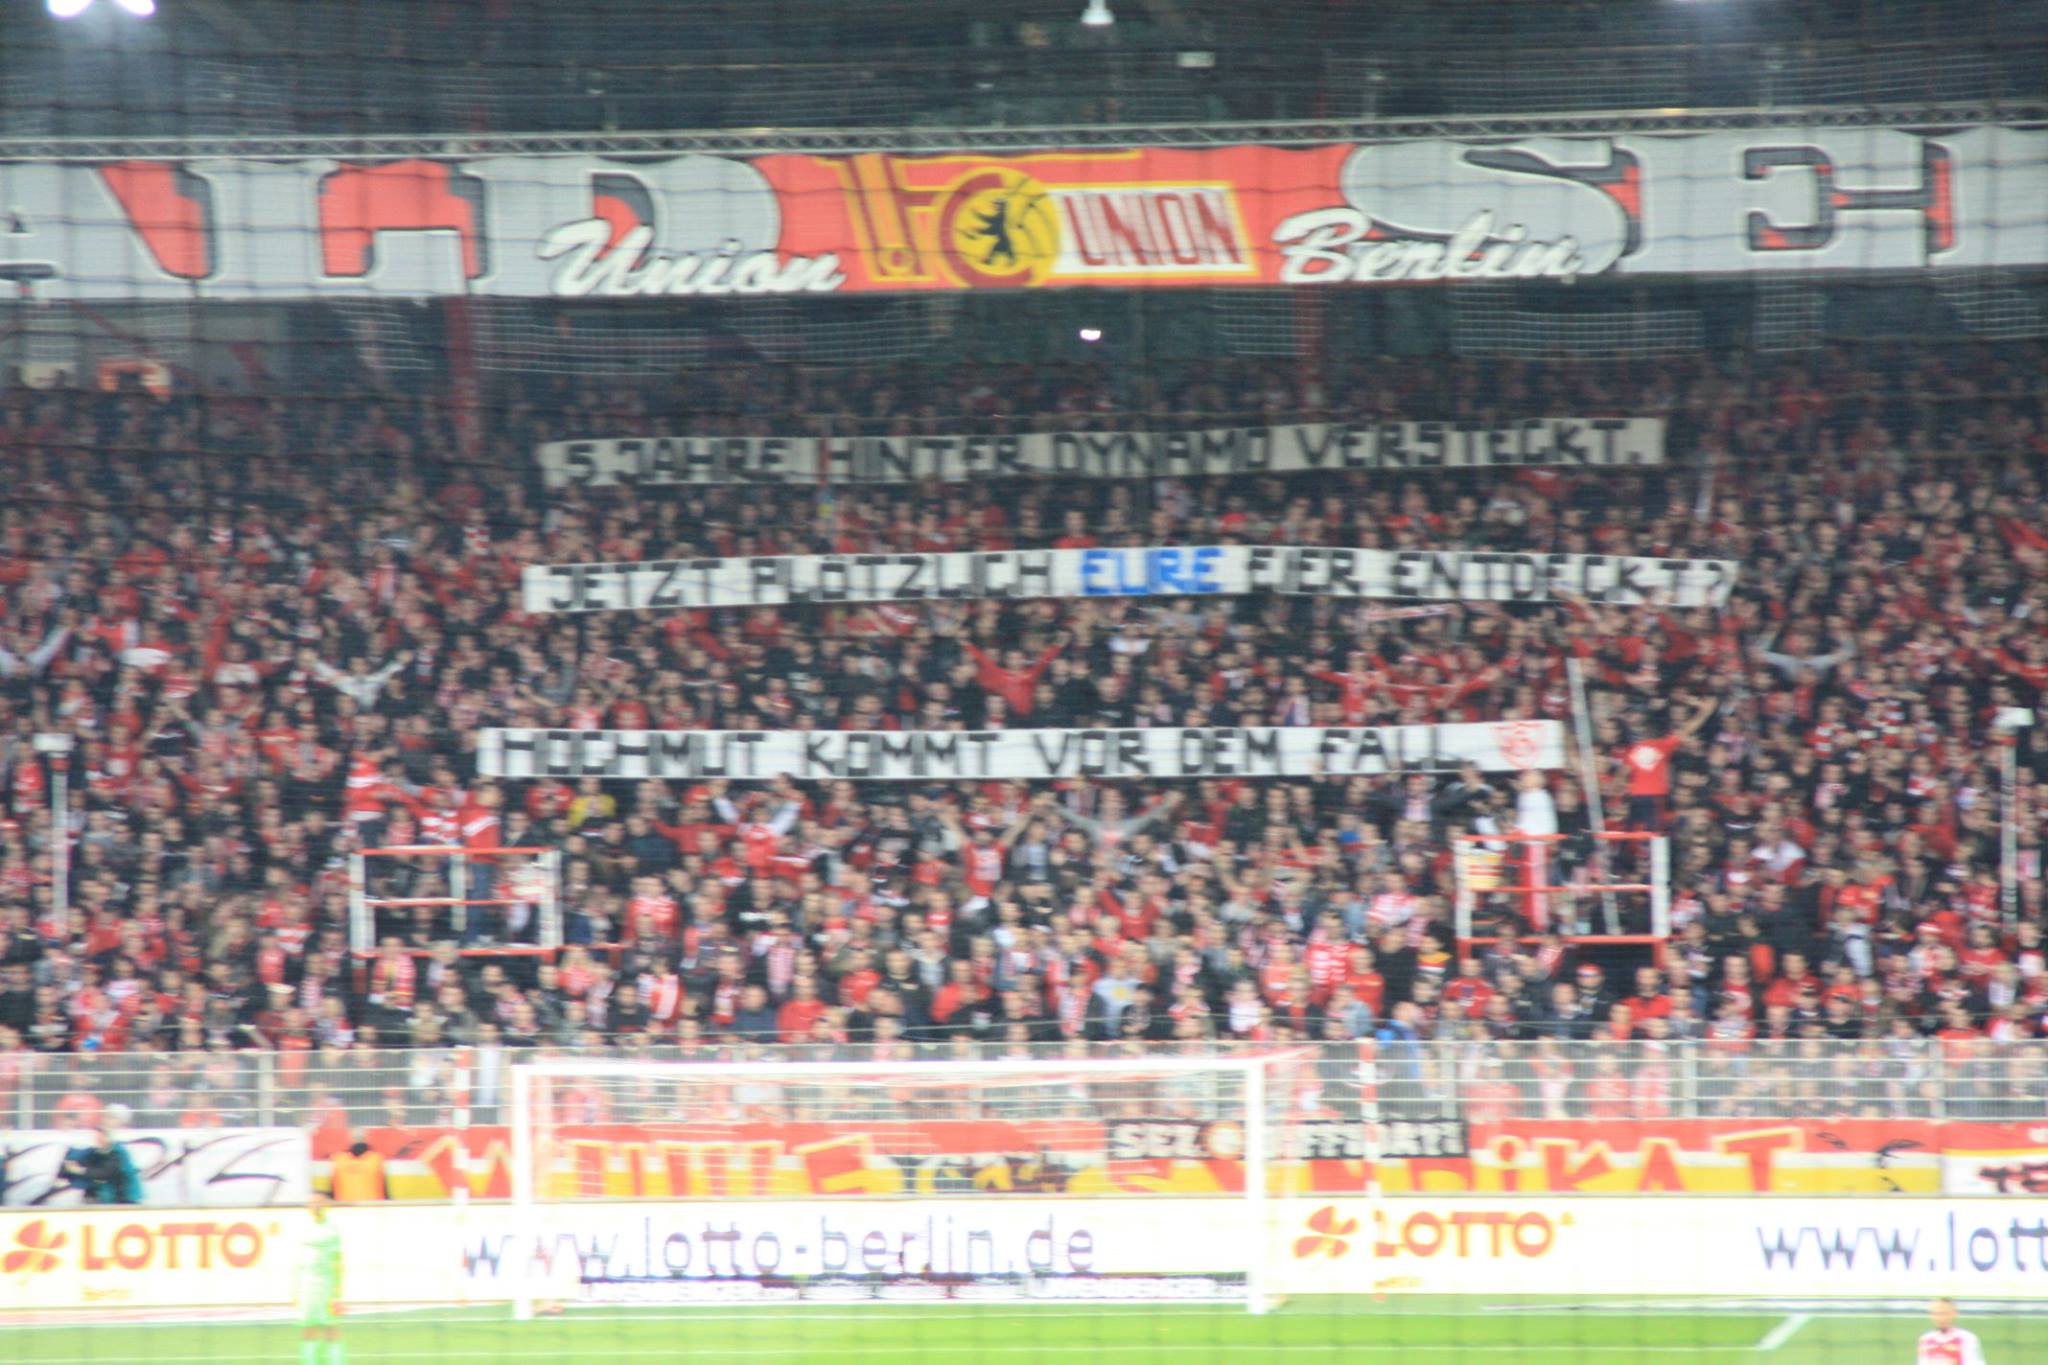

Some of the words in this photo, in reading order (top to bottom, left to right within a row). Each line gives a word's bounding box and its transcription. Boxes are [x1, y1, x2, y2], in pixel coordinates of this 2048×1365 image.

[537, 215, 846, 297] Union
[1273, 207, 1584, 284] Berlin
[1063, 190, 1247, 268] UNION
[614, 438, 791, 484] JAHRE
[818, 436, 1033, 482] HINTER
[1053, 430, 1271, 477] DYNAMO
[550, 560, 723, 610] JETZT
[1081, 548, 1226, 595] EURE
[1248, 548, 1362, 594] EIER
[1393, 551, 1727, 606] ENTDECKT?
[496, 730, 766, 776] HOCHMUT
[802, 730, 998, 777] KOMMT
[1034, 729, 1152, 775] VOR
[1181, 728, 1282, 774] DEM
[1321, 728, 1475, 771] FALL
[82, 1222, 263, 1271] LOTTO
[460, 1214, 1095, 1276] www.lotto-berlin.de
[1374, 1209, 1556, 1259] LOTTO
